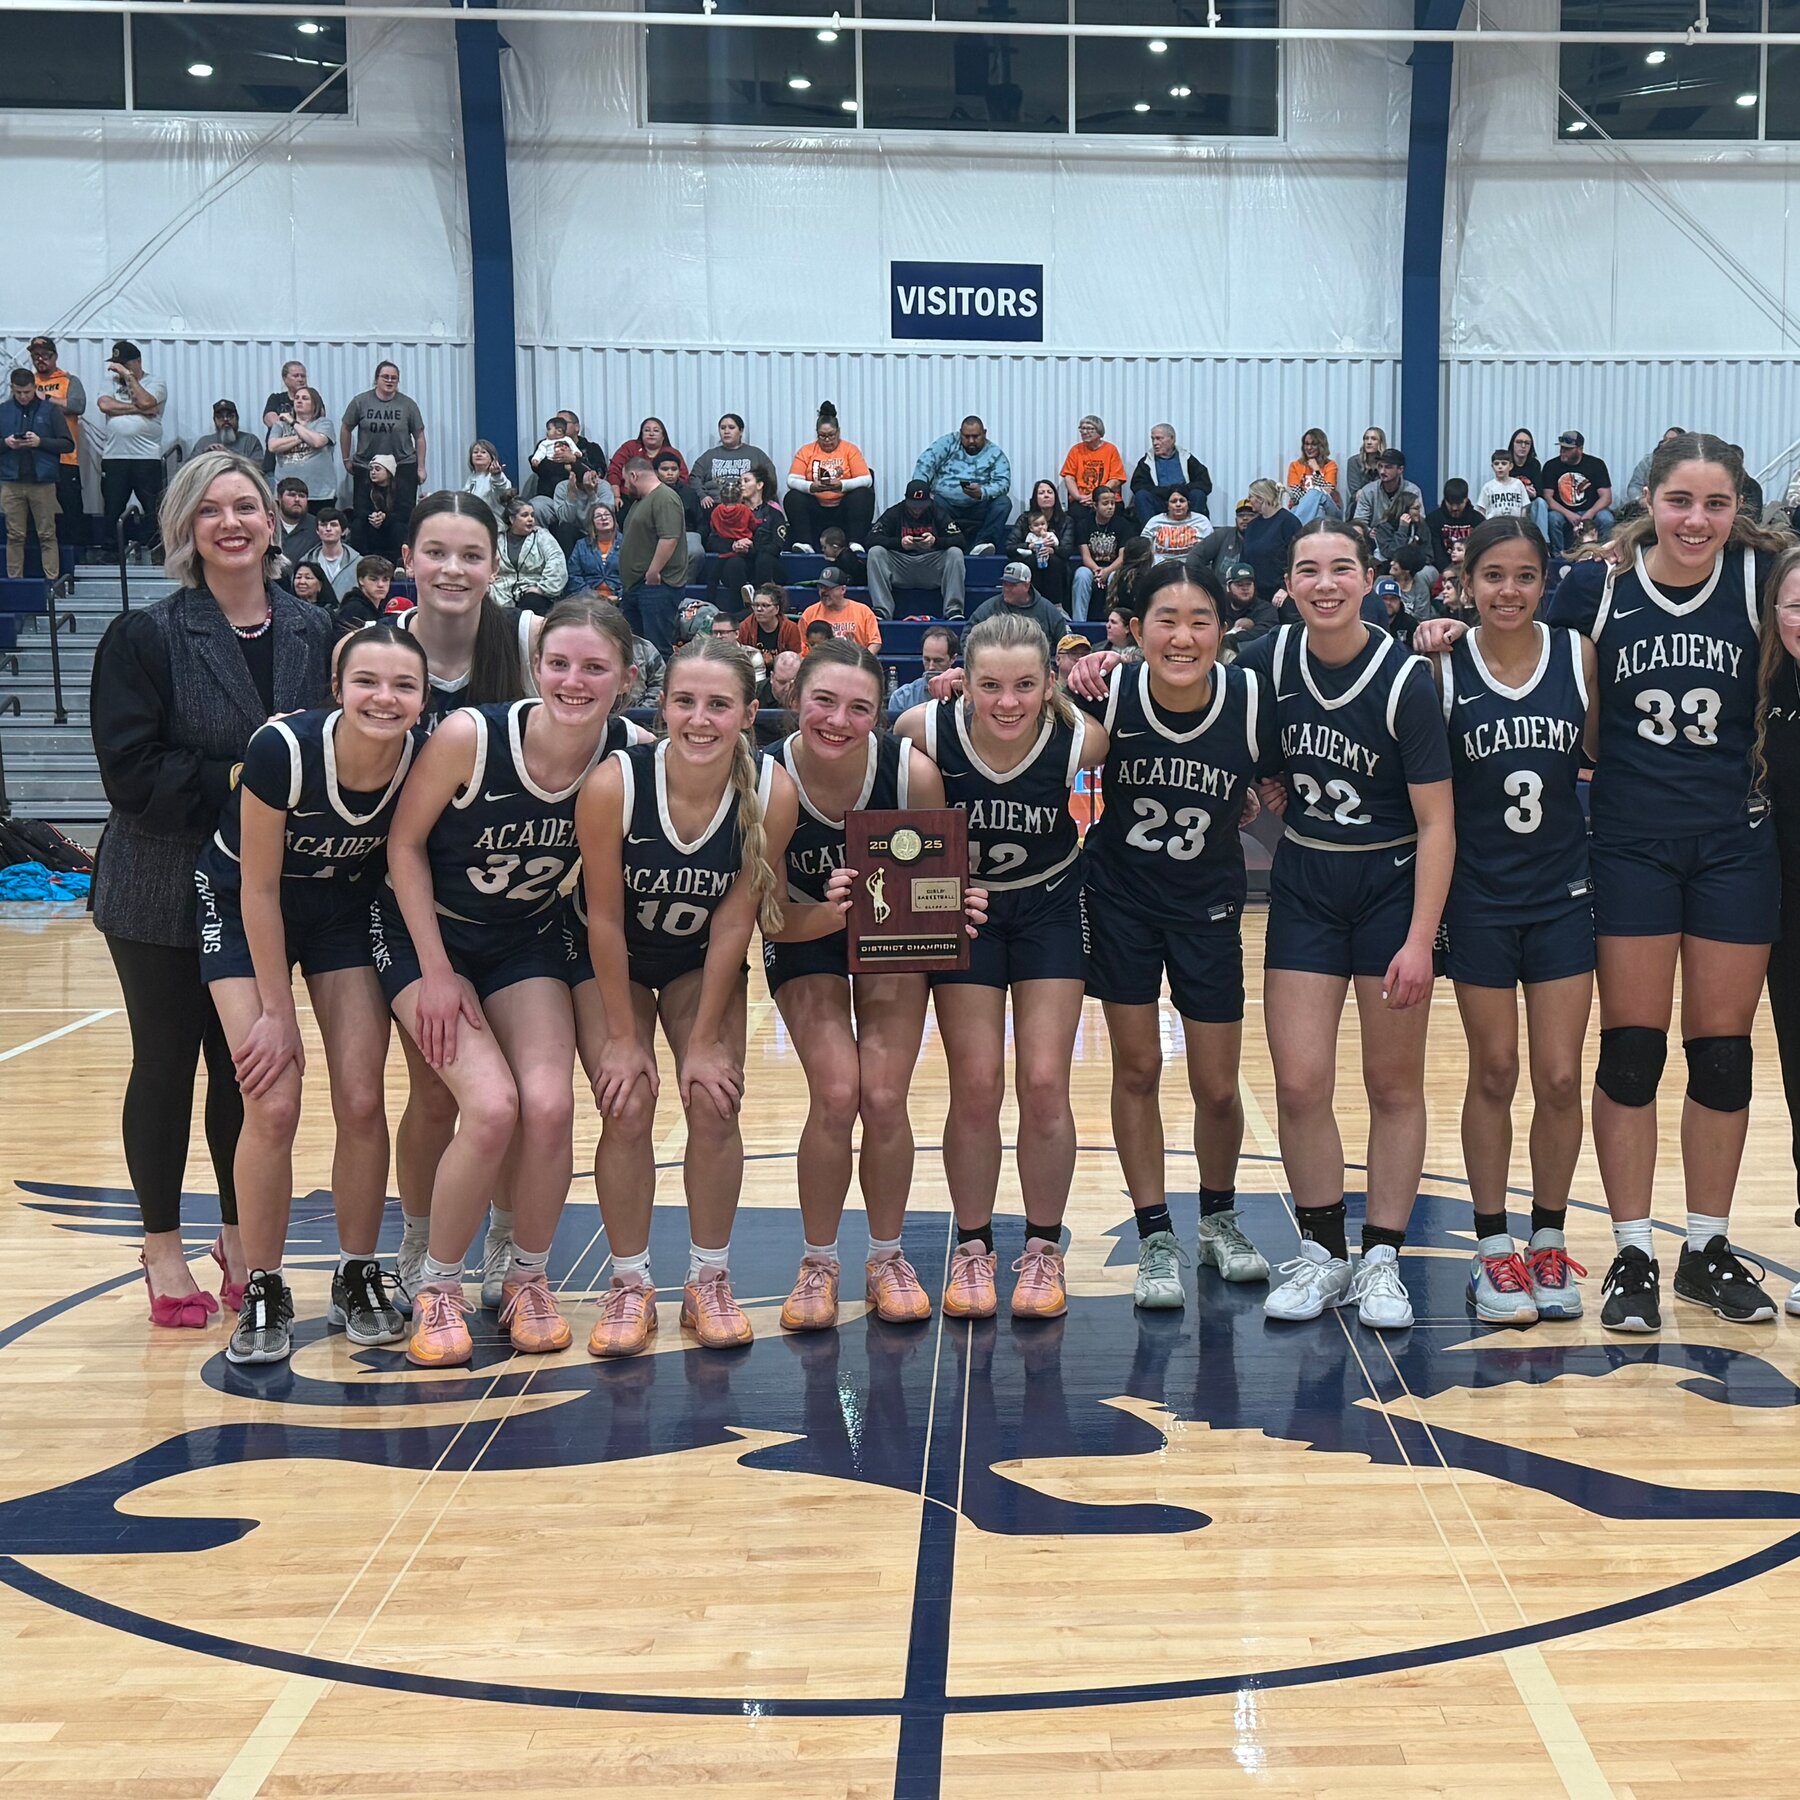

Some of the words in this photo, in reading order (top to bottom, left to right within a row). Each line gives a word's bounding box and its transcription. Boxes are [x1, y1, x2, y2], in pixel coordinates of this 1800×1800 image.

[897, 285, 1038, 317] VISITORS
[366, 408, 401, 420] GAME
[370, 422, 396, 434] DAY
[1614, 633, 1743, 683] ACADEMY
[1463, 716, 1580, 762] ACADEMY
[1634, 687, 1723, 746] 33
[1280, 722, 1381, 778] ACADEMY
[1117, 757, 1238, 801] ACADEMY
[1292, 773, 1373, 826] 22
[1503, 770, 1544, 834] 3
[946, 800, 1059, 834] ADEMY
[1125, 797, 1212, 861] 23
[869, 841, 888, 849] 20
[924, 840, 943, 849] 25
[465, 854, 565, 901] 32
[637, 900, 709, 936] 10
